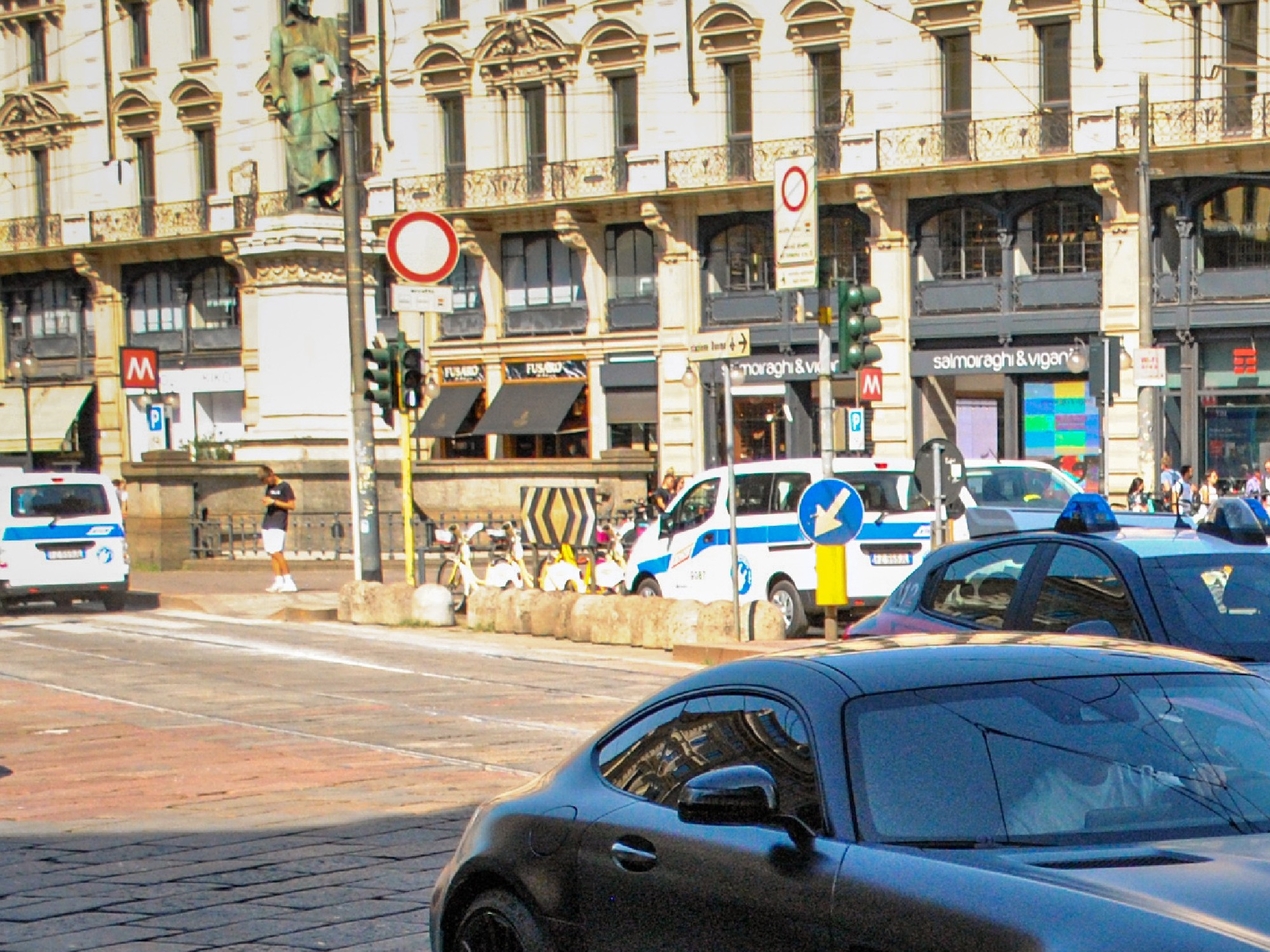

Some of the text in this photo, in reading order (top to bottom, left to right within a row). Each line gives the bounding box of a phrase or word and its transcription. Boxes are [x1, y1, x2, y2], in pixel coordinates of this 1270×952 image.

[126, 356, 156, 381] M
[862, 374, 881, 396] M
[150, 408, 160, 430] P
[851, 411, 860, 431] P
